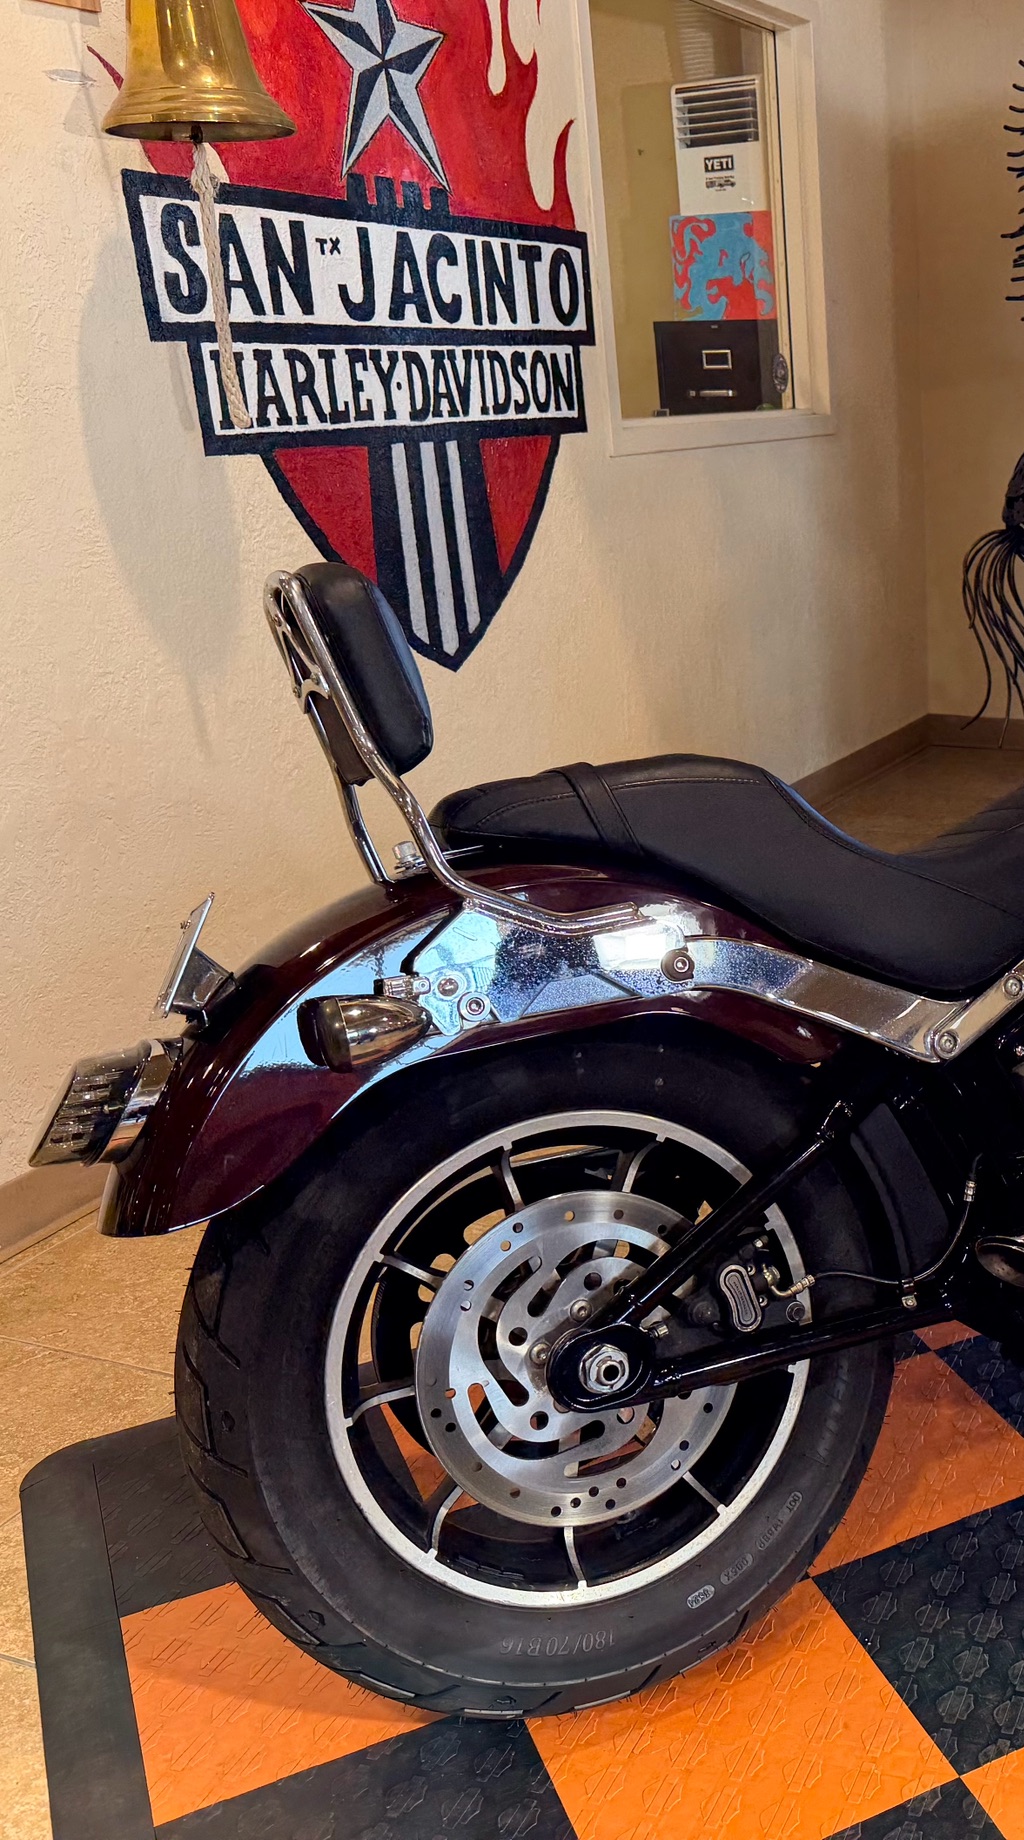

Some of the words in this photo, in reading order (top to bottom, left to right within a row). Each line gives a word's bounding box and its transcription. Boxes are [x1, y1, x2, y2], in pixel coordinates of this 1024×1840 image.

[705, 157, 732, 170] YETI
[160, 203, 314, 316] SAN
[316, 236, 341, 255] TX
[338, 228, 579, 326] JACINTO
[786, 1492, 802, 1514] DOT
